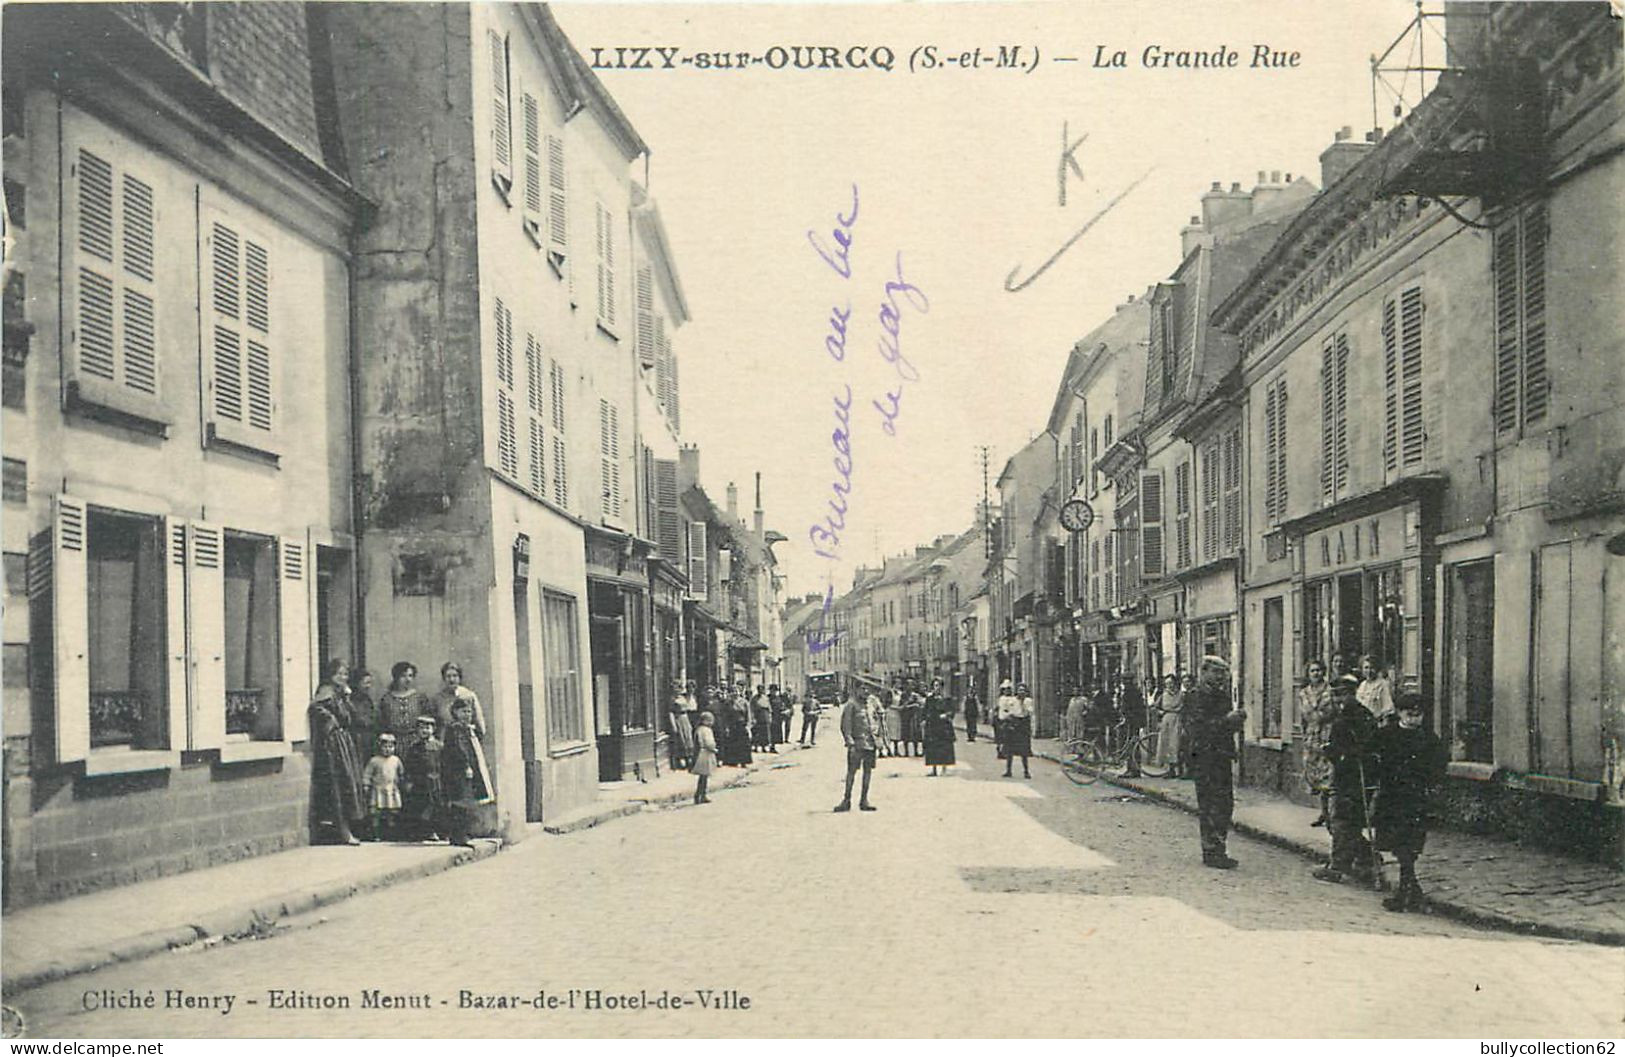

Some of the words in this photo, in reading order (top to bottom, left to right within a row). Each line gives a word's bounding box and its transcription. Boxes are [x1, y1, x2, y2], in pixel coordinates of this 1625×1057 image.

[825, 306, 852, 362] au
[873, 385, 902, 437] de
[809, 384, 852, 561] Bureau
